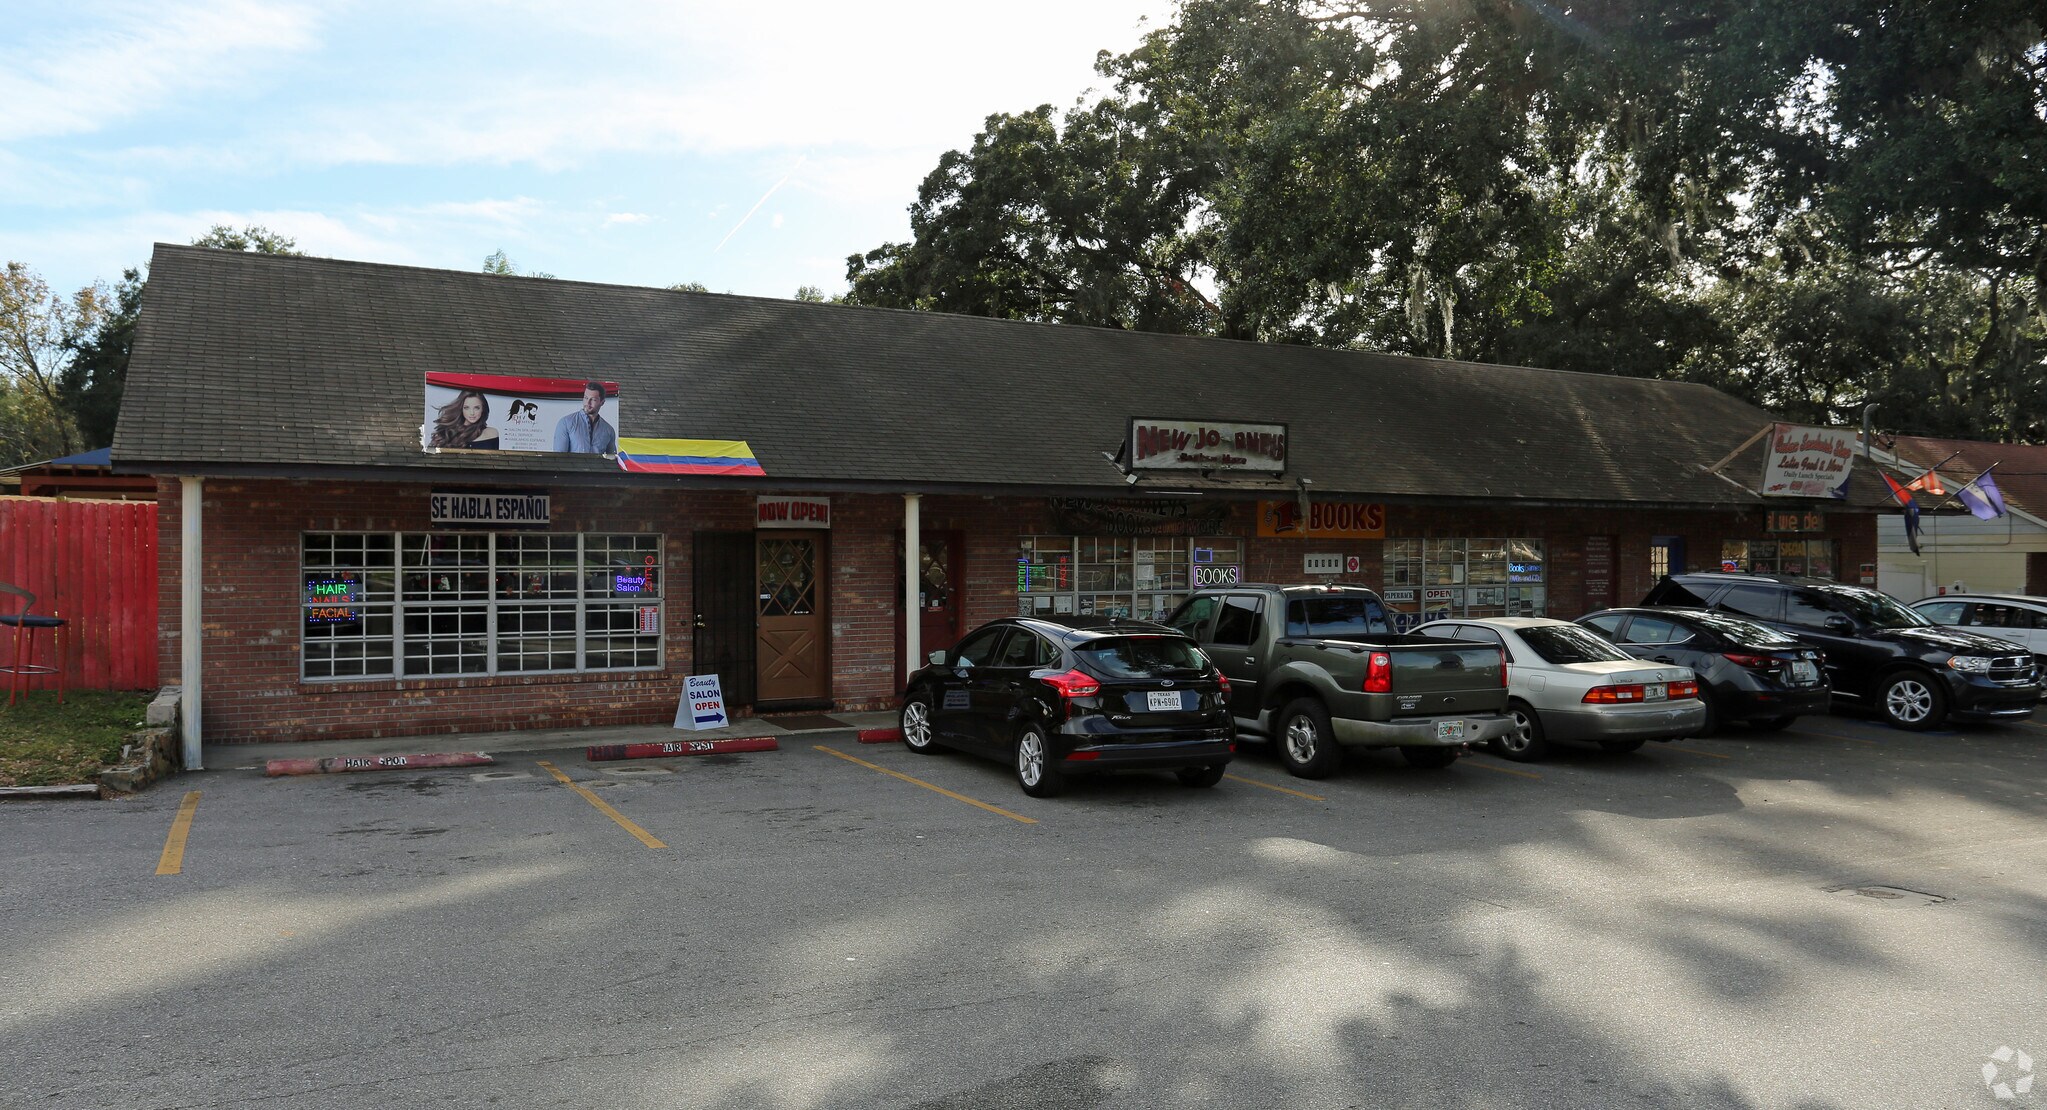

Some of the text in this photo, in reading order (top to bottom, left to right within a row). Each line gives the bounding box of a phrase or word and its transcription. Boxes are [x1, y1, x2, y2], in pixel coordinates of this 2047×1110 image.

[1138, 426, 1191, 460] NEW
[1778, 455, 1799, 469] Latin
[1783, 470, 1834, 480] Daily Lunch Specials
[431, 495, 549, 520] SE HABLA ESPAÑOL
[759, 501, 829, 523] NOW OPEN!
[1104, 510, 1152, 536] BOOKS
[1186, 518, 1225, 536] MORE
[1308, 502, 1382, 532] BOOKS
[1778, 513, 1798, 530] we
[1508, 562, 1525, 573] Books
[616, 575, 646, 586] Beauty
[1196, 567, 1237, 584] BOOKS
[316, 583, 347, 595] HAIR
[616, 584, 640, 592] Salon
[1426, 590, 1452, 598] OPEN
[311, 607, 352, 619] FACIAL
[689, 677, 716, 688] Beauty
[689, 689, 720, 700] SALON
[695, 701, 720, 711] OPEN
[345, 758, 371, 768] HAIR
